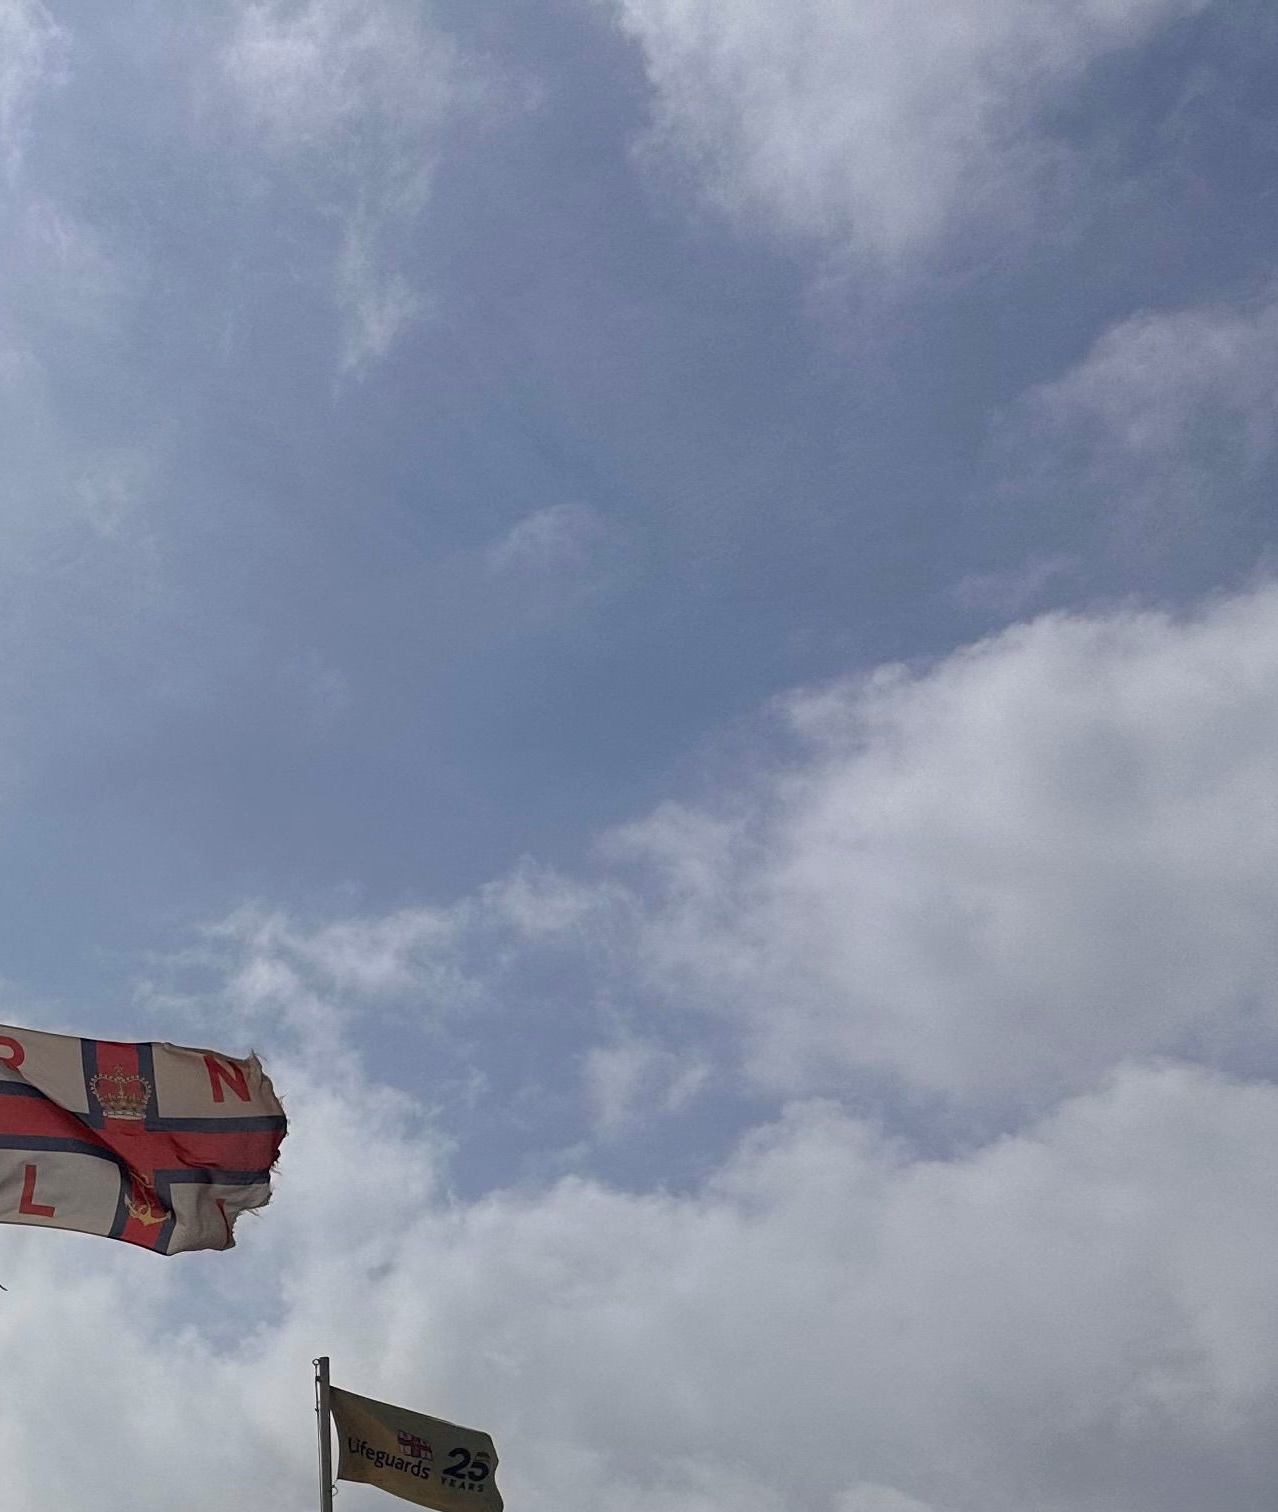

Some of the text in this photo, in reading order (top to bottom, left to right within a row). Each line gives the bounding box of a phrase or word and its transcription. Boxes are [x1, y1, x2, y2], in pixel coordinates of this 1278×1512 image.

[203, 1055, 251, 1103] N
[19, 1164, 55, 1217] L
[348, 1437, 431, 1480] Lifeguards
[443, 1448, 490, 1482] 25
[441, 1477, 484, 1493] YEARS
